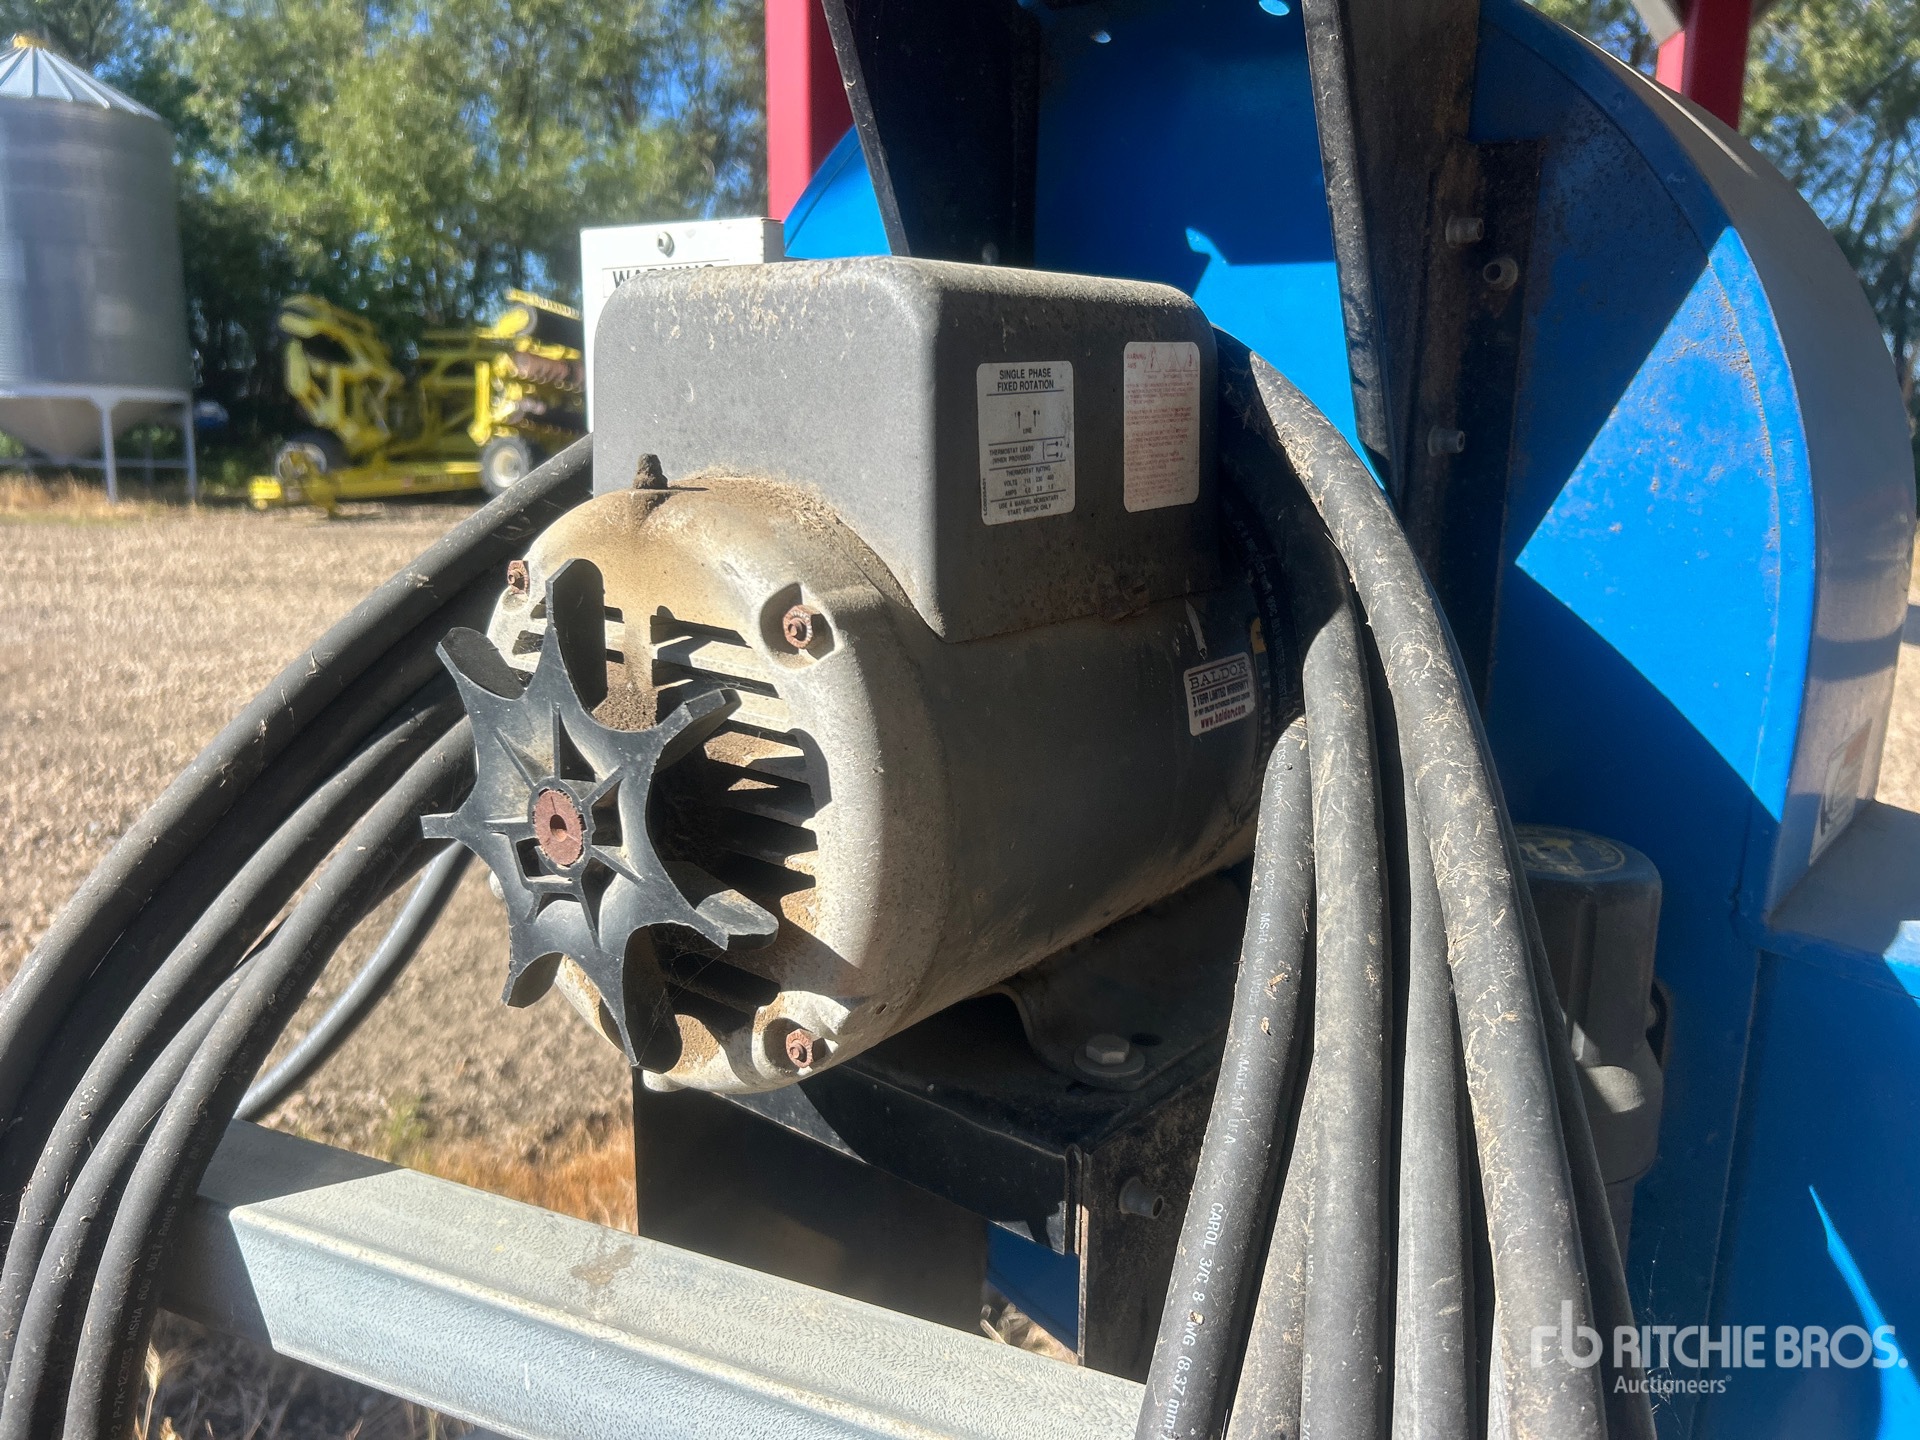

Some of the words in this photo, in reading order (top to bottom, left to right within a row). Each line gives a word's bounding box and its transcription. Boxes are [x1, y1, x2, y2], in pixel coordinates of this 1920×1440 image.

[999, 369, 1025, 380] SINGLE
[1028, 367, 1052, 378] PHASE
[997, 381, 1018, 392] FIXED
[1019, 380, 1054, 391] ROTATION
[1022, 427, 1032, 435] LINE
[989, 447, 1018, 456] THERMOSTAT
[1019, 445, 1034, 453] LEADS
[1004, 479, 1018, 487] VOLTS
[1006, 467, 1034, 477] THERMOSTAT
[1035, 465, 1051, 474] RATING
[998, 502, 1007, 510] USE
[1033, 494, 1059, 504] MOMENTARY
[1189, 662, 1248, 690] BALDOR
[1200, 704, 1246, 729] www.baldor.com
[1276, 749, 1287, 769] CSA
[1256, 911, 1270, 944] MSHA
[276, 977, 298, 1001] AWG
[1234, 1054, 1249, 1090] MADE
[1203, 1202, 1224, 1248] CAROL
[127, 1307, 144, 1340] MSHA
[145, 1243, 164, 1273] VOLT
[158, 1205, 178, 1238] RoHS
[172, 1166, 194, 1200] MADE
[1196, 1256, 1213, 1284] 3/C
[1192, 1290, 1205, 1302] 8
[1173, 1355, 1193, 1396] (8.37
[1302, 1353, 1312, 1406] CAROL
